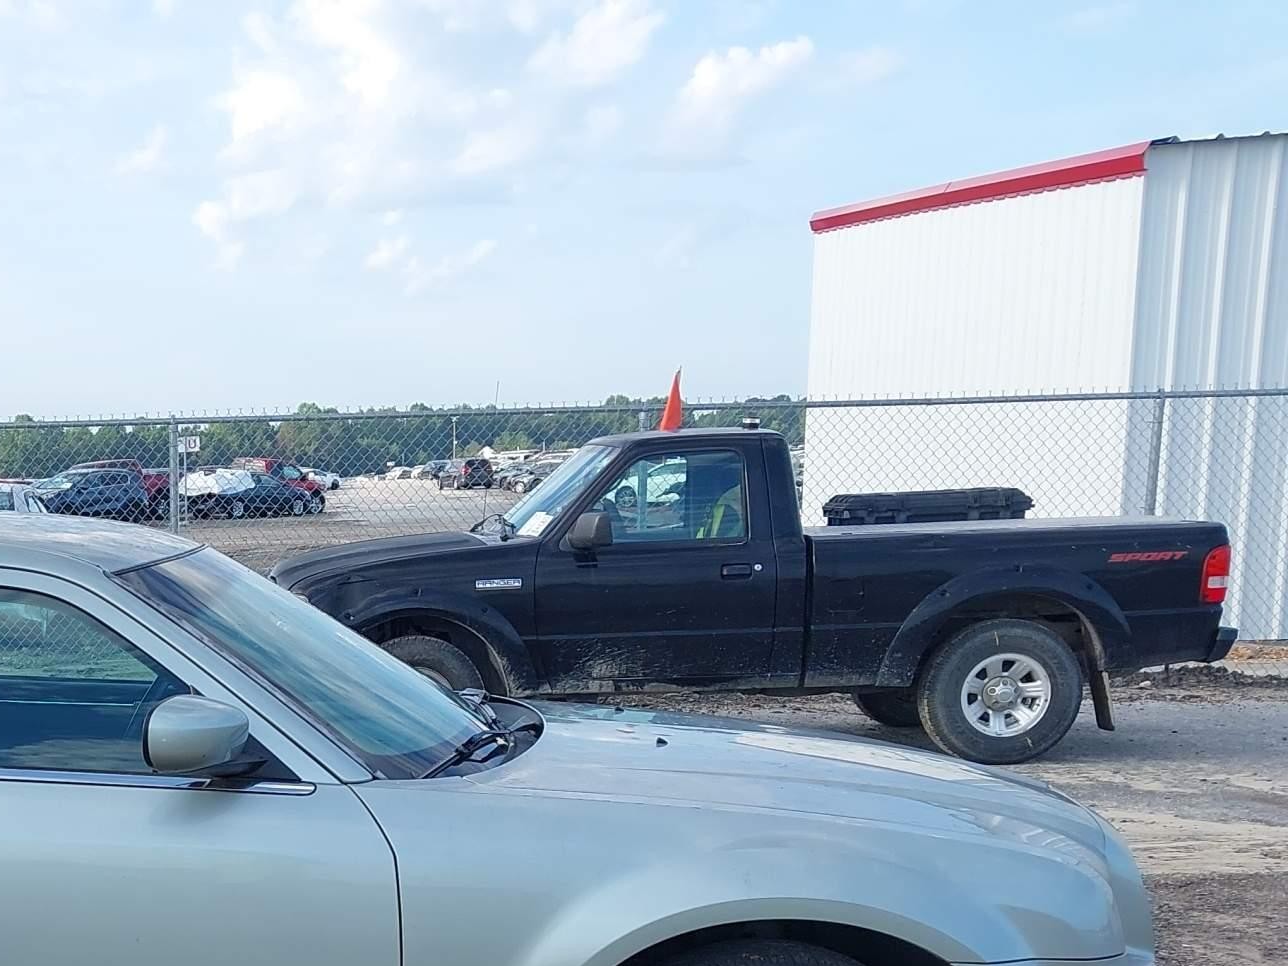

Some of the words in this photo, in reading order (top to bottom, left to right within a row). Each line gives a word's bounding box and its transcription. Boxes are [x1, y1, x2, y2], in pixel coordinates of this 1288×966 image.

[188, 439, 197, 449] U
[1107, 551, 1188, 562] SPORT
[476, 579, 521, 588] RANGER
